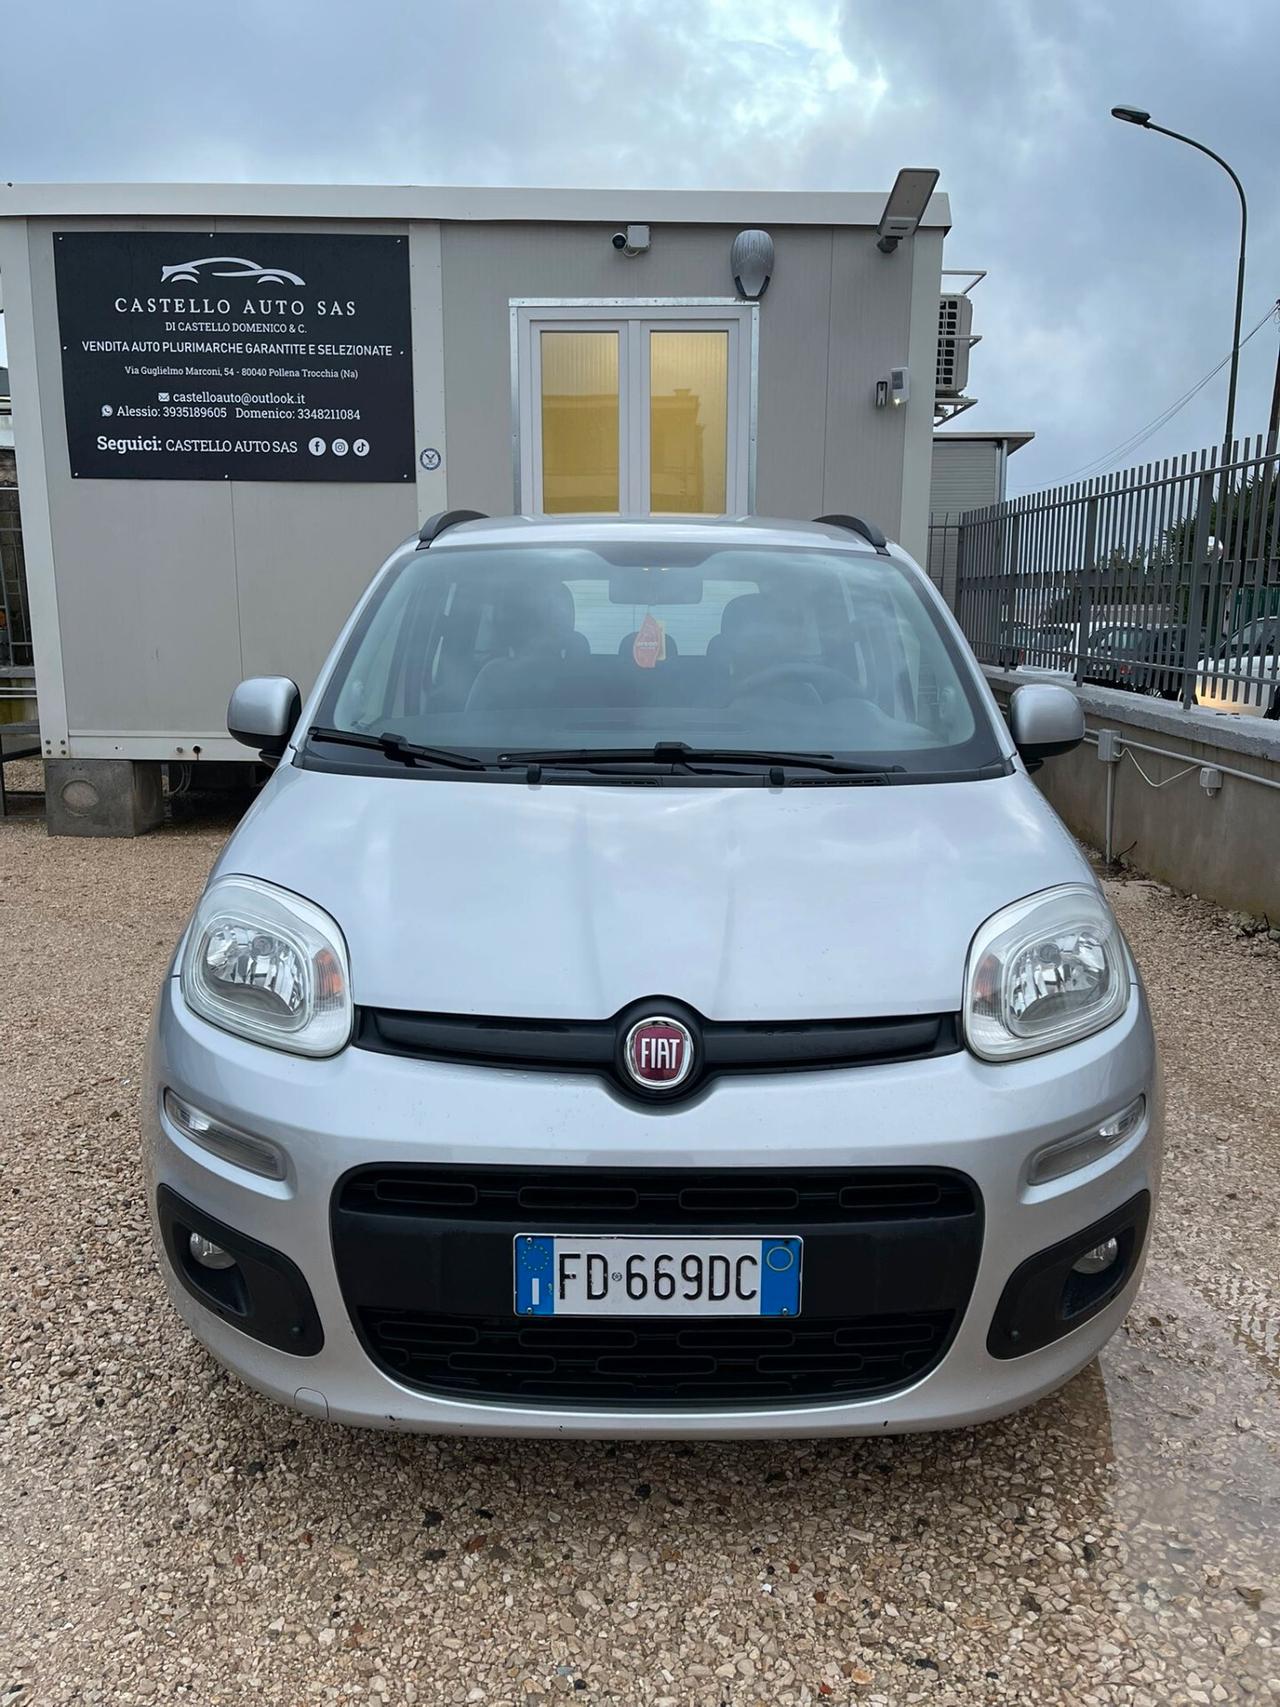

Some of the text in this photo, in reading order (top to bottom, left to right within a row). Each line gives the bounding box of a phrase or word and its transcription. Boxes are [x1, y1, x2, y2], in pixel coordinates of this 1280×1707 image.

[114, 297, 356, 316] CASTELLO AUTO SAS
[165, 321, 307, 334] DI CASTELLO DOMENICO & C.
[81, 340, 393, 357] VENDITA AUTO PLURIMARCHE GARANTITE E SELEZIONATE
[124, 365, 140, 375] Via
[140, 366, 184, 377] Guglielmo
[185, 366, 223, 377] Marconi,
[223, 367, 235, 376] 54
[241, 367, 267, 377] 80040
[268, 367, 301, 378] Pollena
[301, 368, 339, 378] Trocchia
[340, 369, 359, 380] (Na)
[173, 391, 306, 406] castelloauto@outlook.it
[117, 405, 361, 420] Alessio: 3935189605 Domenico: 3348211084
[96, 435, 298, 455] Seguici: CASTELLO AUTO SAS
[640, 1037, 681, 1070] FIAT
[558, 1253, 758, 1302] FD 669DC
